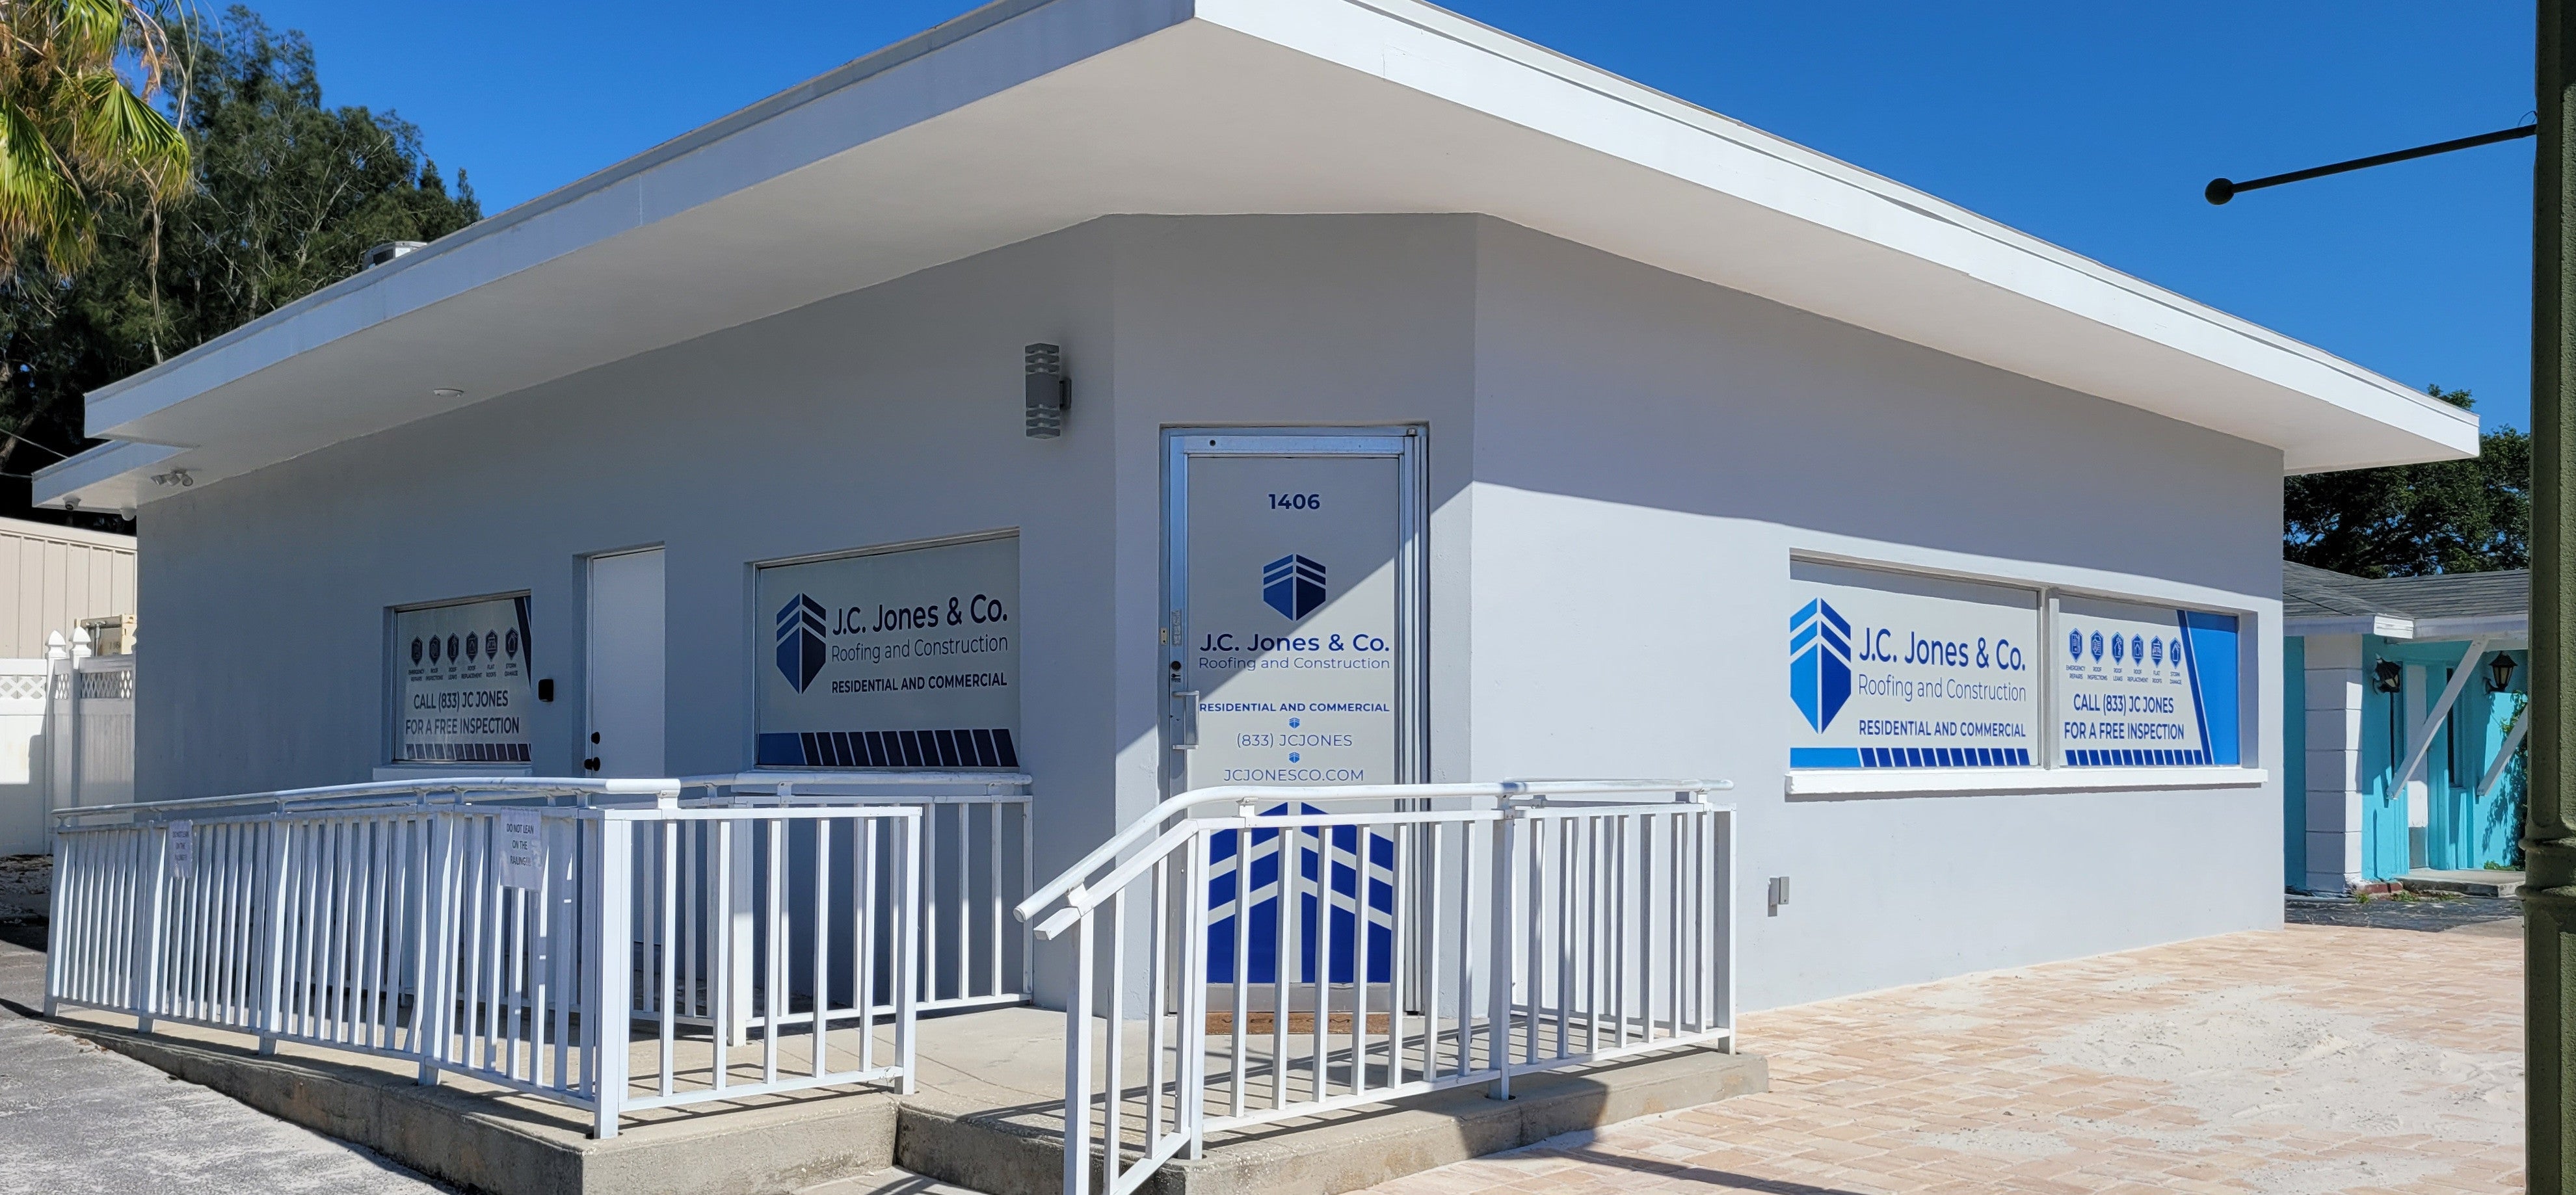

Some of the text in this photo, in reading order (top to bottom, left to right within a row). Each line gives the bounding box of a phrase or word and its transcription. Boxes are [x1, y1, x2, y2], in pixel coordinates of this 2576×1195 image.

[1269, 493, 1320, 510] 1406
[832, 594, 1007, 635] J.C. Jones & Co.
[832, 634, 1007, 664] Roofing and Construction
[1200, 634, 1389, 651] J.C. Jones & Co.
[1859, 627, 2025, 671] J.C. Jones & Co.
[1199, 657, 1390, 672] Roofing and Construction
[832, 672, 1007, 694] RESIDENTIAL AND COMMERCIAL
[1859, 674, 2026, 702] Roofing and Construction
[414, 690, 508, 712] CALL (833) JC JONES
[1200, 703, 1390, 712] RESIDENTIAL AND COMMERCIAL
[2074, 694, 2173, 716] CALL (833) JC JONES
[406, 717, 519, 735] FOR A FREE INSPECTION
[1859, 720, 2026, 737] RESIDENTIAL AND COMMERCIAL
[2064, 722, 2184, 740] FOR A FREE INSPECTION
[1236, 733, 1352, 749] (833) JCJONES
[1223, 769, 1364, 781] JCJONESCO.COM
[514, 824, 522, 833] NOT
[523, 824, 534, 834] LEAN
[512, 840, 518, 849] ON
